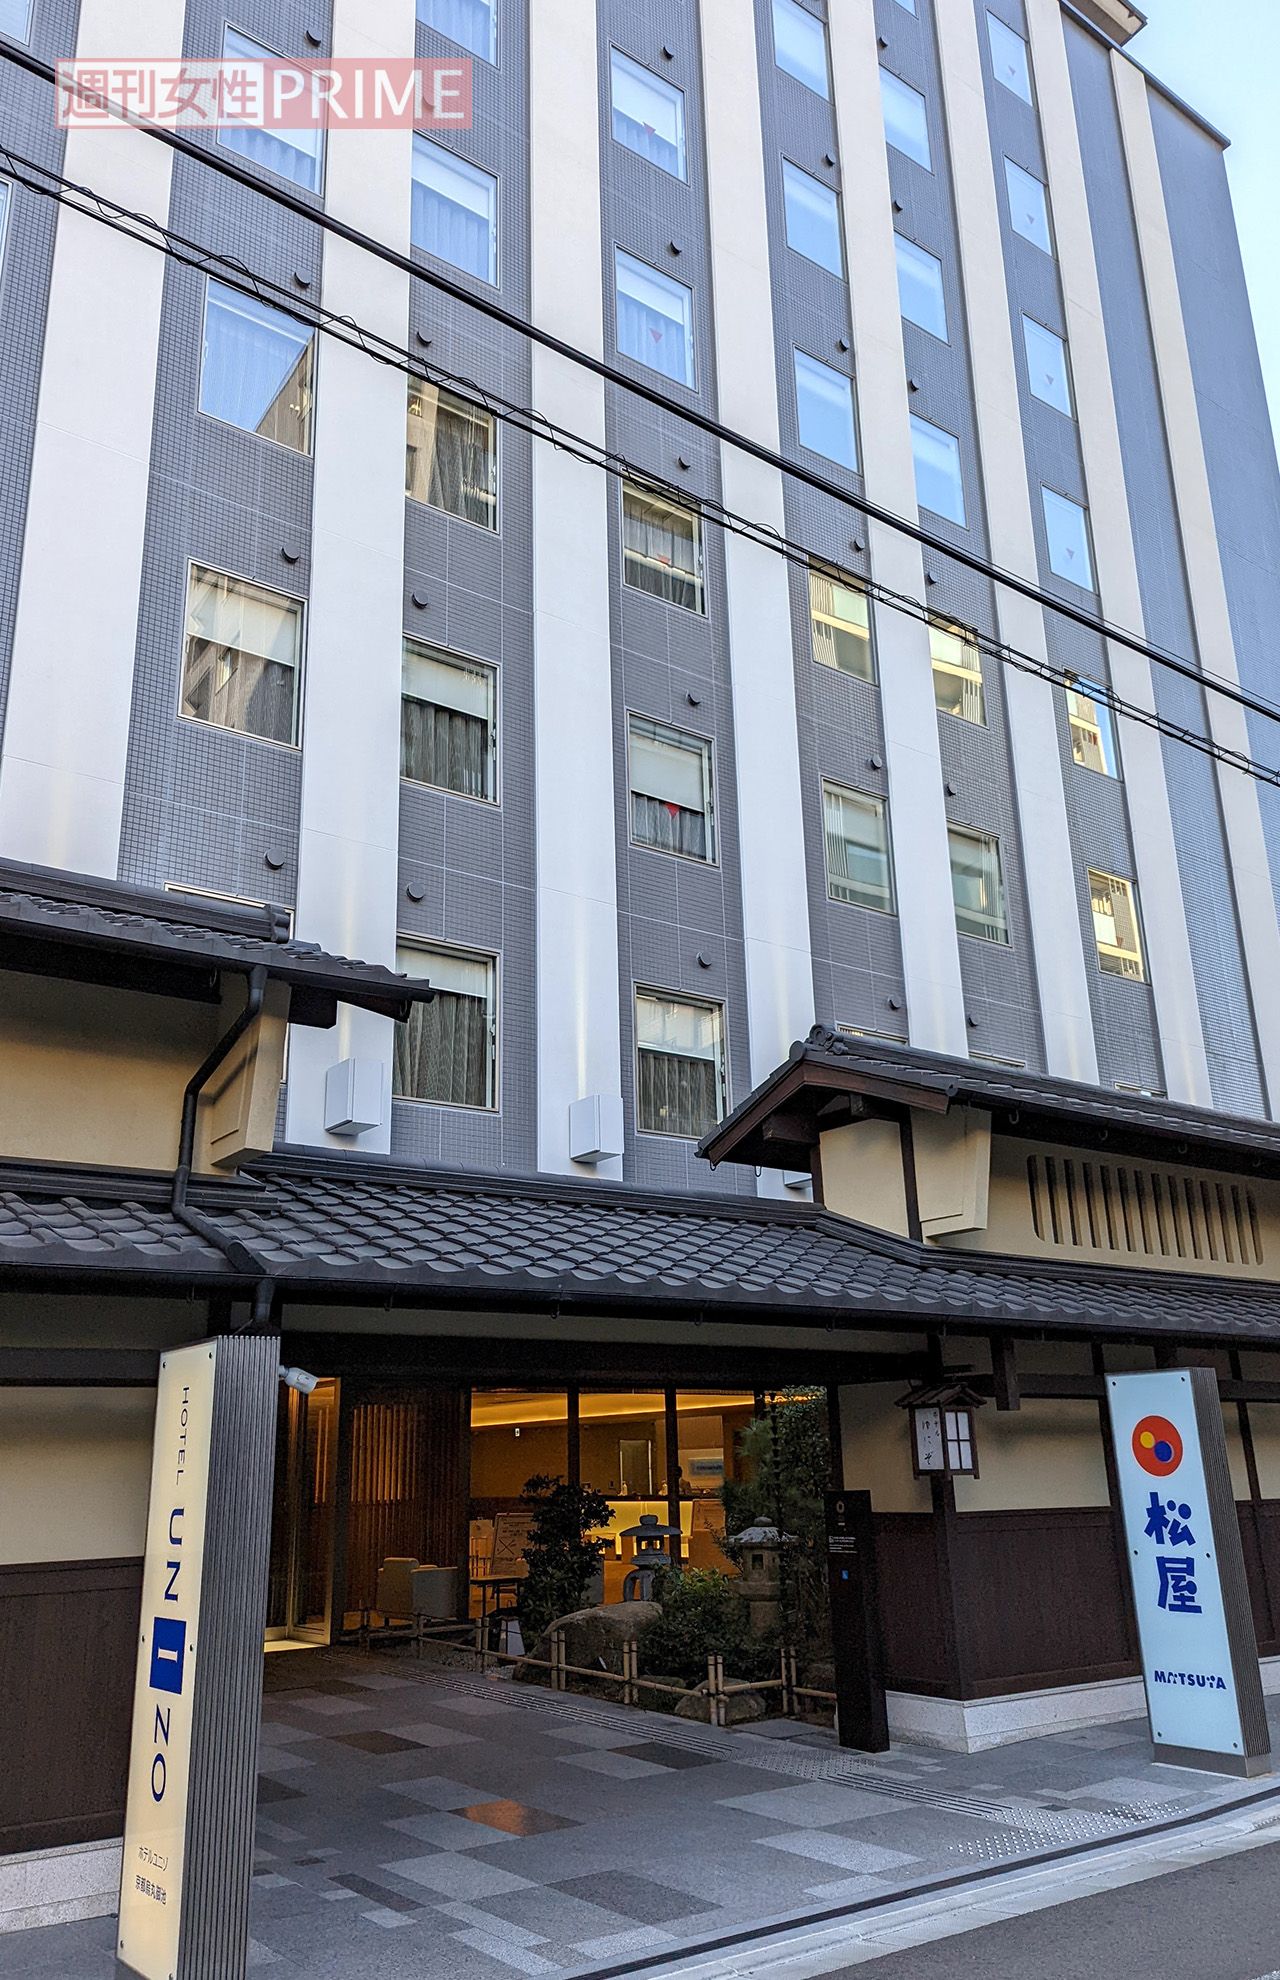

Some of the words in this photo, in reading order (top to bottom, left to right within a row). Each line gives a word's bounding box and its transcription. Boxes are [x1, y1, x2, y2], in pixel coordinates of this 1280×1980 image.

[176, 1387, 190, 1486] HOTEL
[1144, 1491, 1203, 1614] 松屋
[151, 1508, 186, 1803] UNIZO
[1154, 1670, 1227, 1690] MATSUYA
